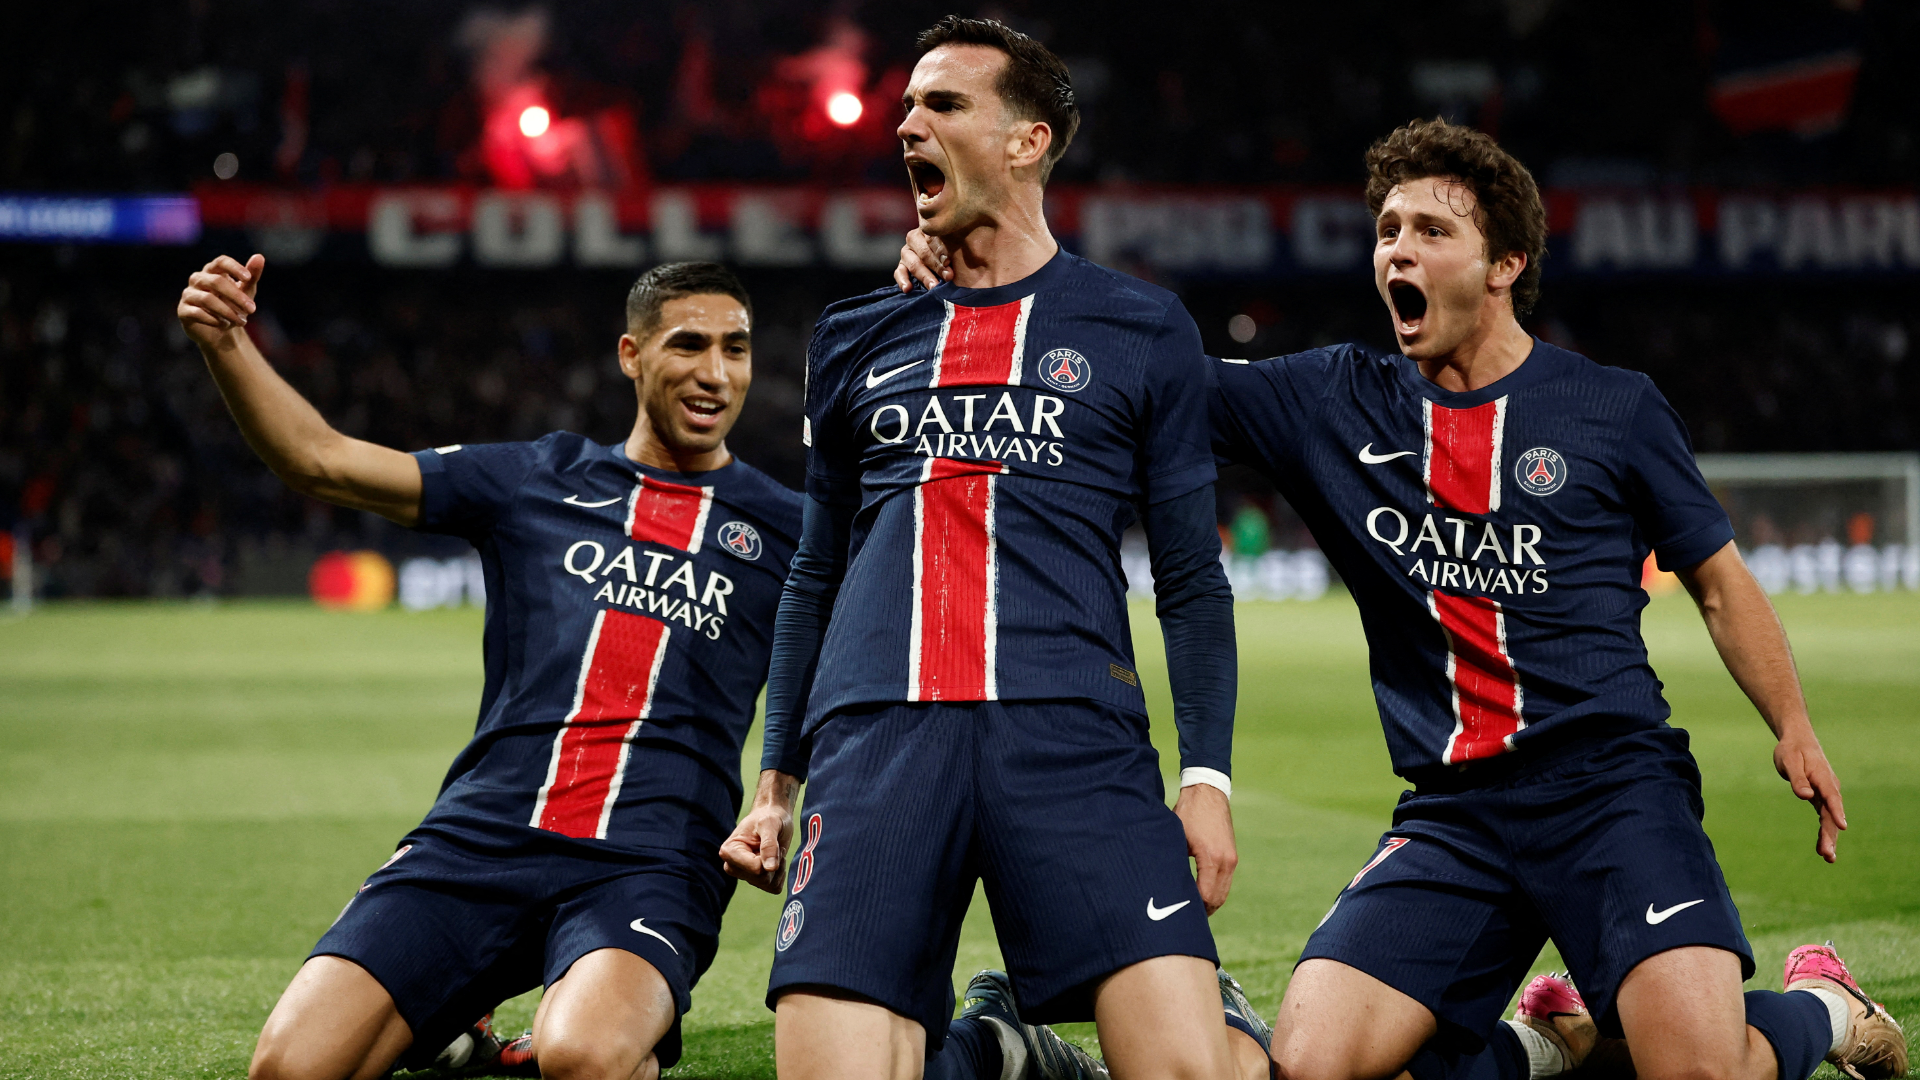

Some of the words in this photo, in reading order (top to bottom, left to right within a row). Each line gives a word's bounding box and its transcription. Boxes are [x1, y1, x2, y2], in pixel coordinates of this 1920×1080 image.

[1049, 350, 1083, 364] PARIS
[870, 391, 1066, 444] QATAR
[914, 433, 1065, 467] AIRWAYS
[1524, 450, 1559, 463] PARIS
[728, 523, 758, 541] PARIS
[1366, 506, 1546, 565] QATAR
[563, 540, 735, 617] QATAR
[1408, 558, 1549, 594] AIRWAYS
[593, 580, 725, 641] AIRWAYS
[791, 812, 822, 895] 8
[1346, 836, 1411, 890] 7
[784, 902, 802, 919] PARIS
